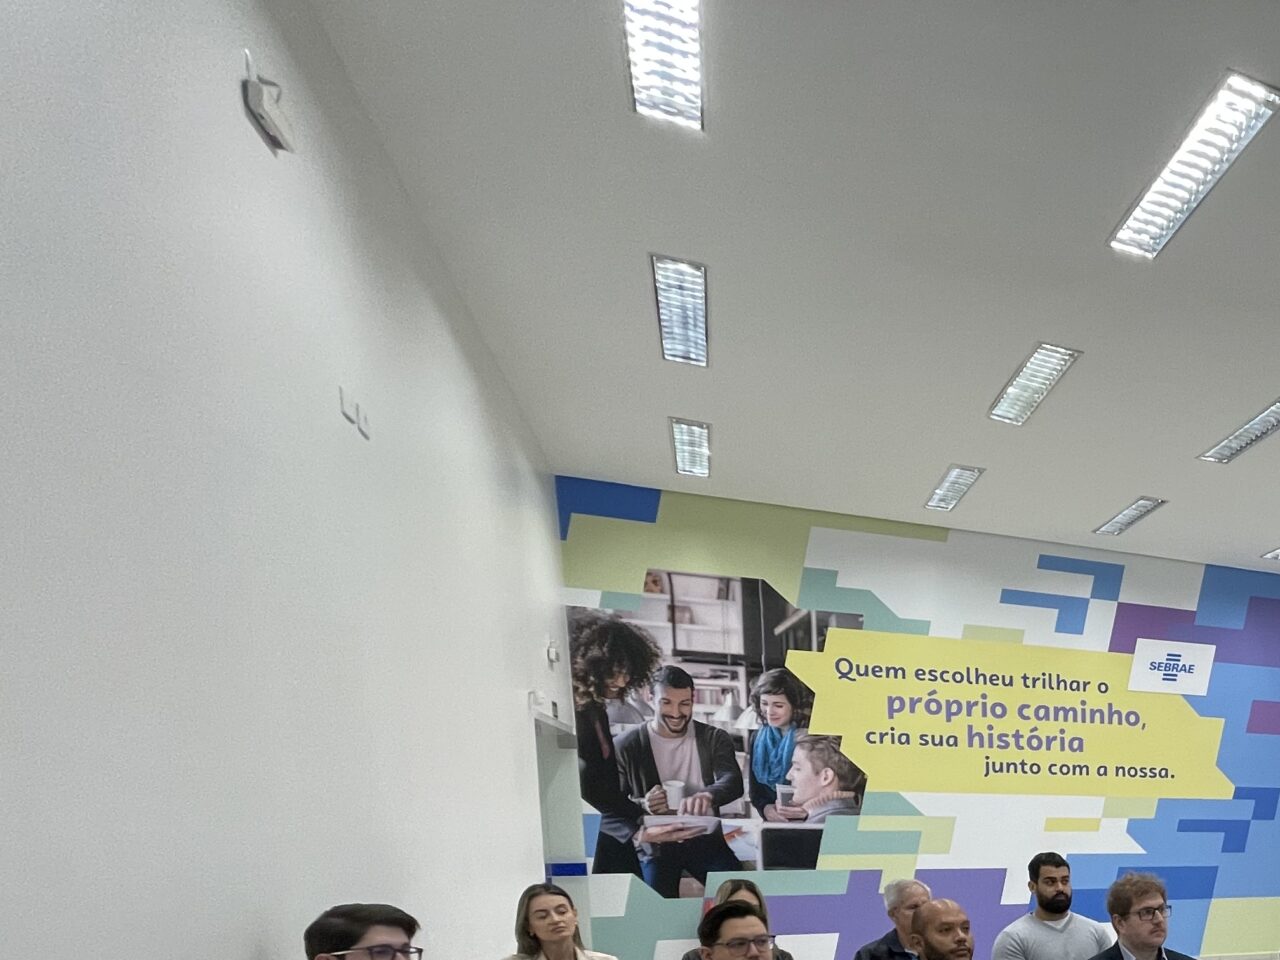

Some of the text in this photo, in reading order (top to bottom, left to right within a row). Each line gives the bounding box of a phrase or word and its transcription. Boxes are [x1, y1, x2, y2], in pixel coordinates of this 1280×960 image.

[834, 657, 1110, 695] Quem escolheu trilhar o
[1149, 661, 1195, 674] SEBRAE
[886, 689, 1147, 731] próprio caminho,
[865, 725, 1086, 753] cria sua história
[983, 755, 1176, 780] junto com a nossa.
